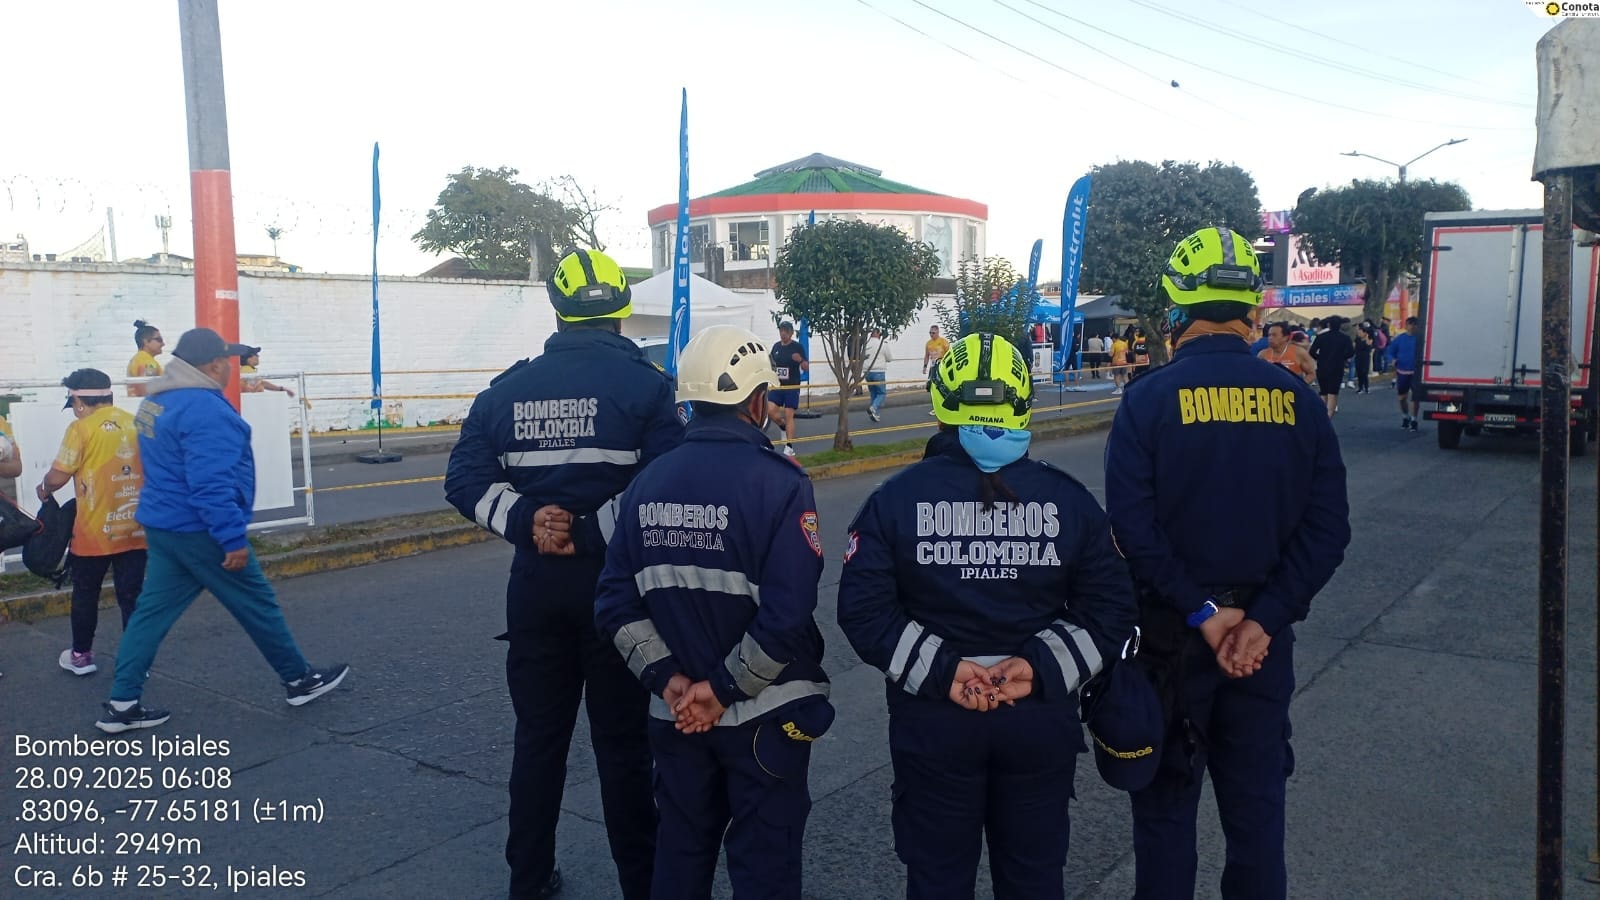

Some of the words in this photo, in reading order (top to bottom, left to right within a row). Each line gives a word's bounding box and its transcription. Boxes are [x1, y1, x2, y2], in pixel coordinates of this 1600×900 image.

[1289, 292, 1329, 305] Ipiales
[512, 398, 599, 421] BOMBEROS
[1178, 387, 1296, 425] BOMBEROS
[514, 418, 596, 440] COLOMBIA
[968, 415, 1004, 425] ADRIANA
[538, 438, 576, 449] IPIALES
[638, 502, 729, 531] BOMBEROS
[916, 500, 1060, 538] BOMBEROS
[642, 529, 726, 552] COLOMBIA
[916, 540, 1061, 567] COLOMBIA
[960, 567, 1018, 580] IPIALES
